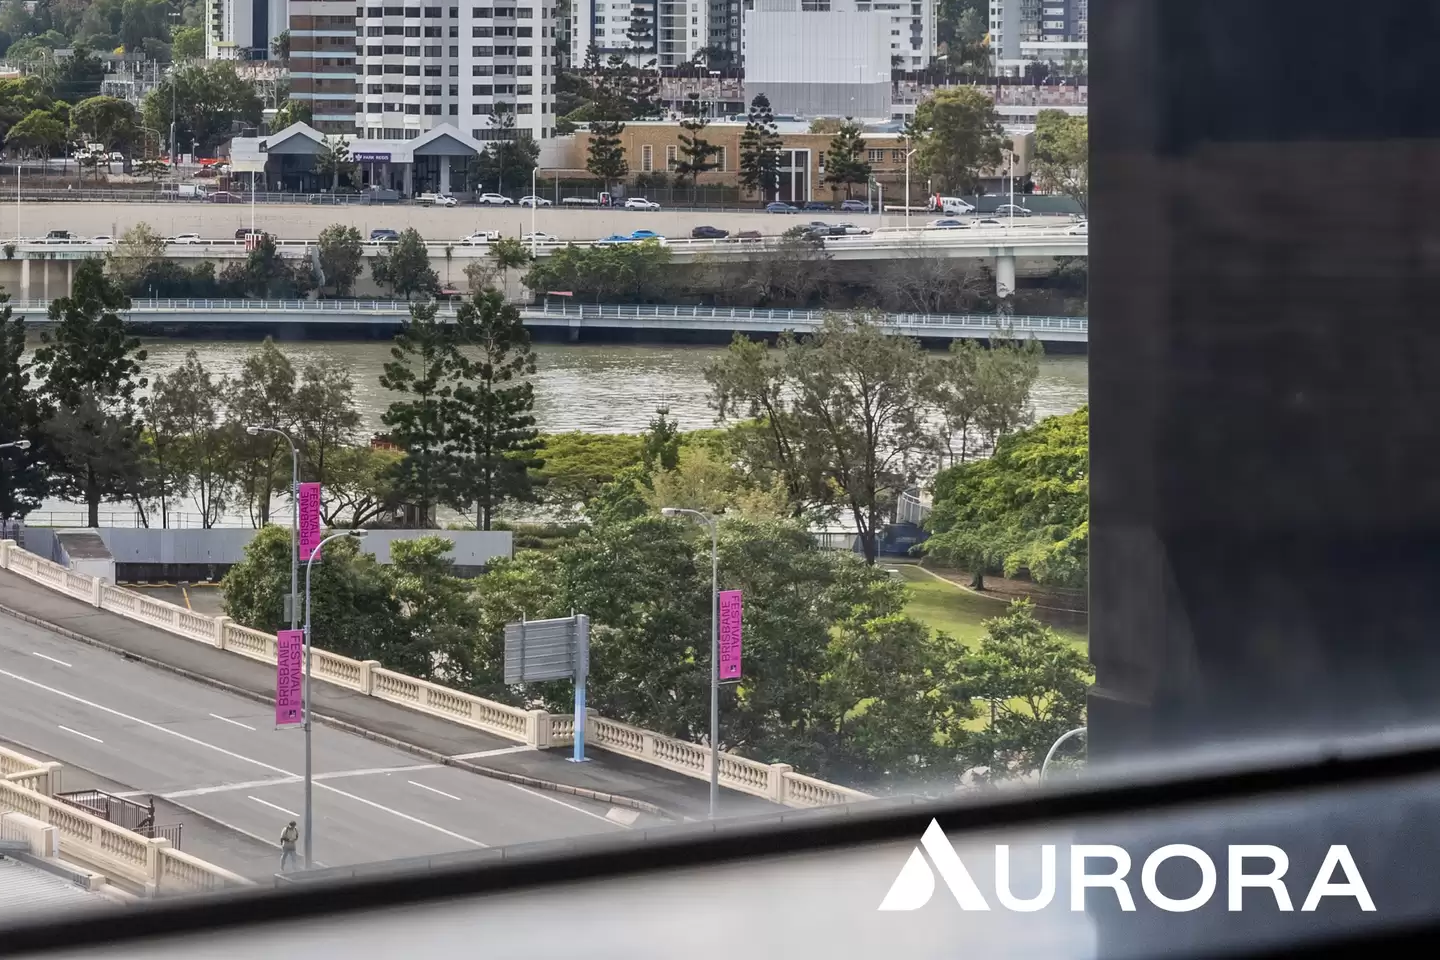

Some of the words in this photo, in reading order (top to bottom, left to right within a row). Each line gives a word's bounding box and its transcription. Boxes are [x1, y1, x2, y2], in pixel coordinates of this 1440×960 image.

[301, 491, 310, 546] BRISBANE
[309, 487, 319, 537] FESTIVAL
[721, 600, 731, 662] BRISBANE
[730, 595, 740, 652] FESTIVAL
[279, 640, 289, 707] BRISBANE
[290, 635, 301, 697] FESTIVAL
